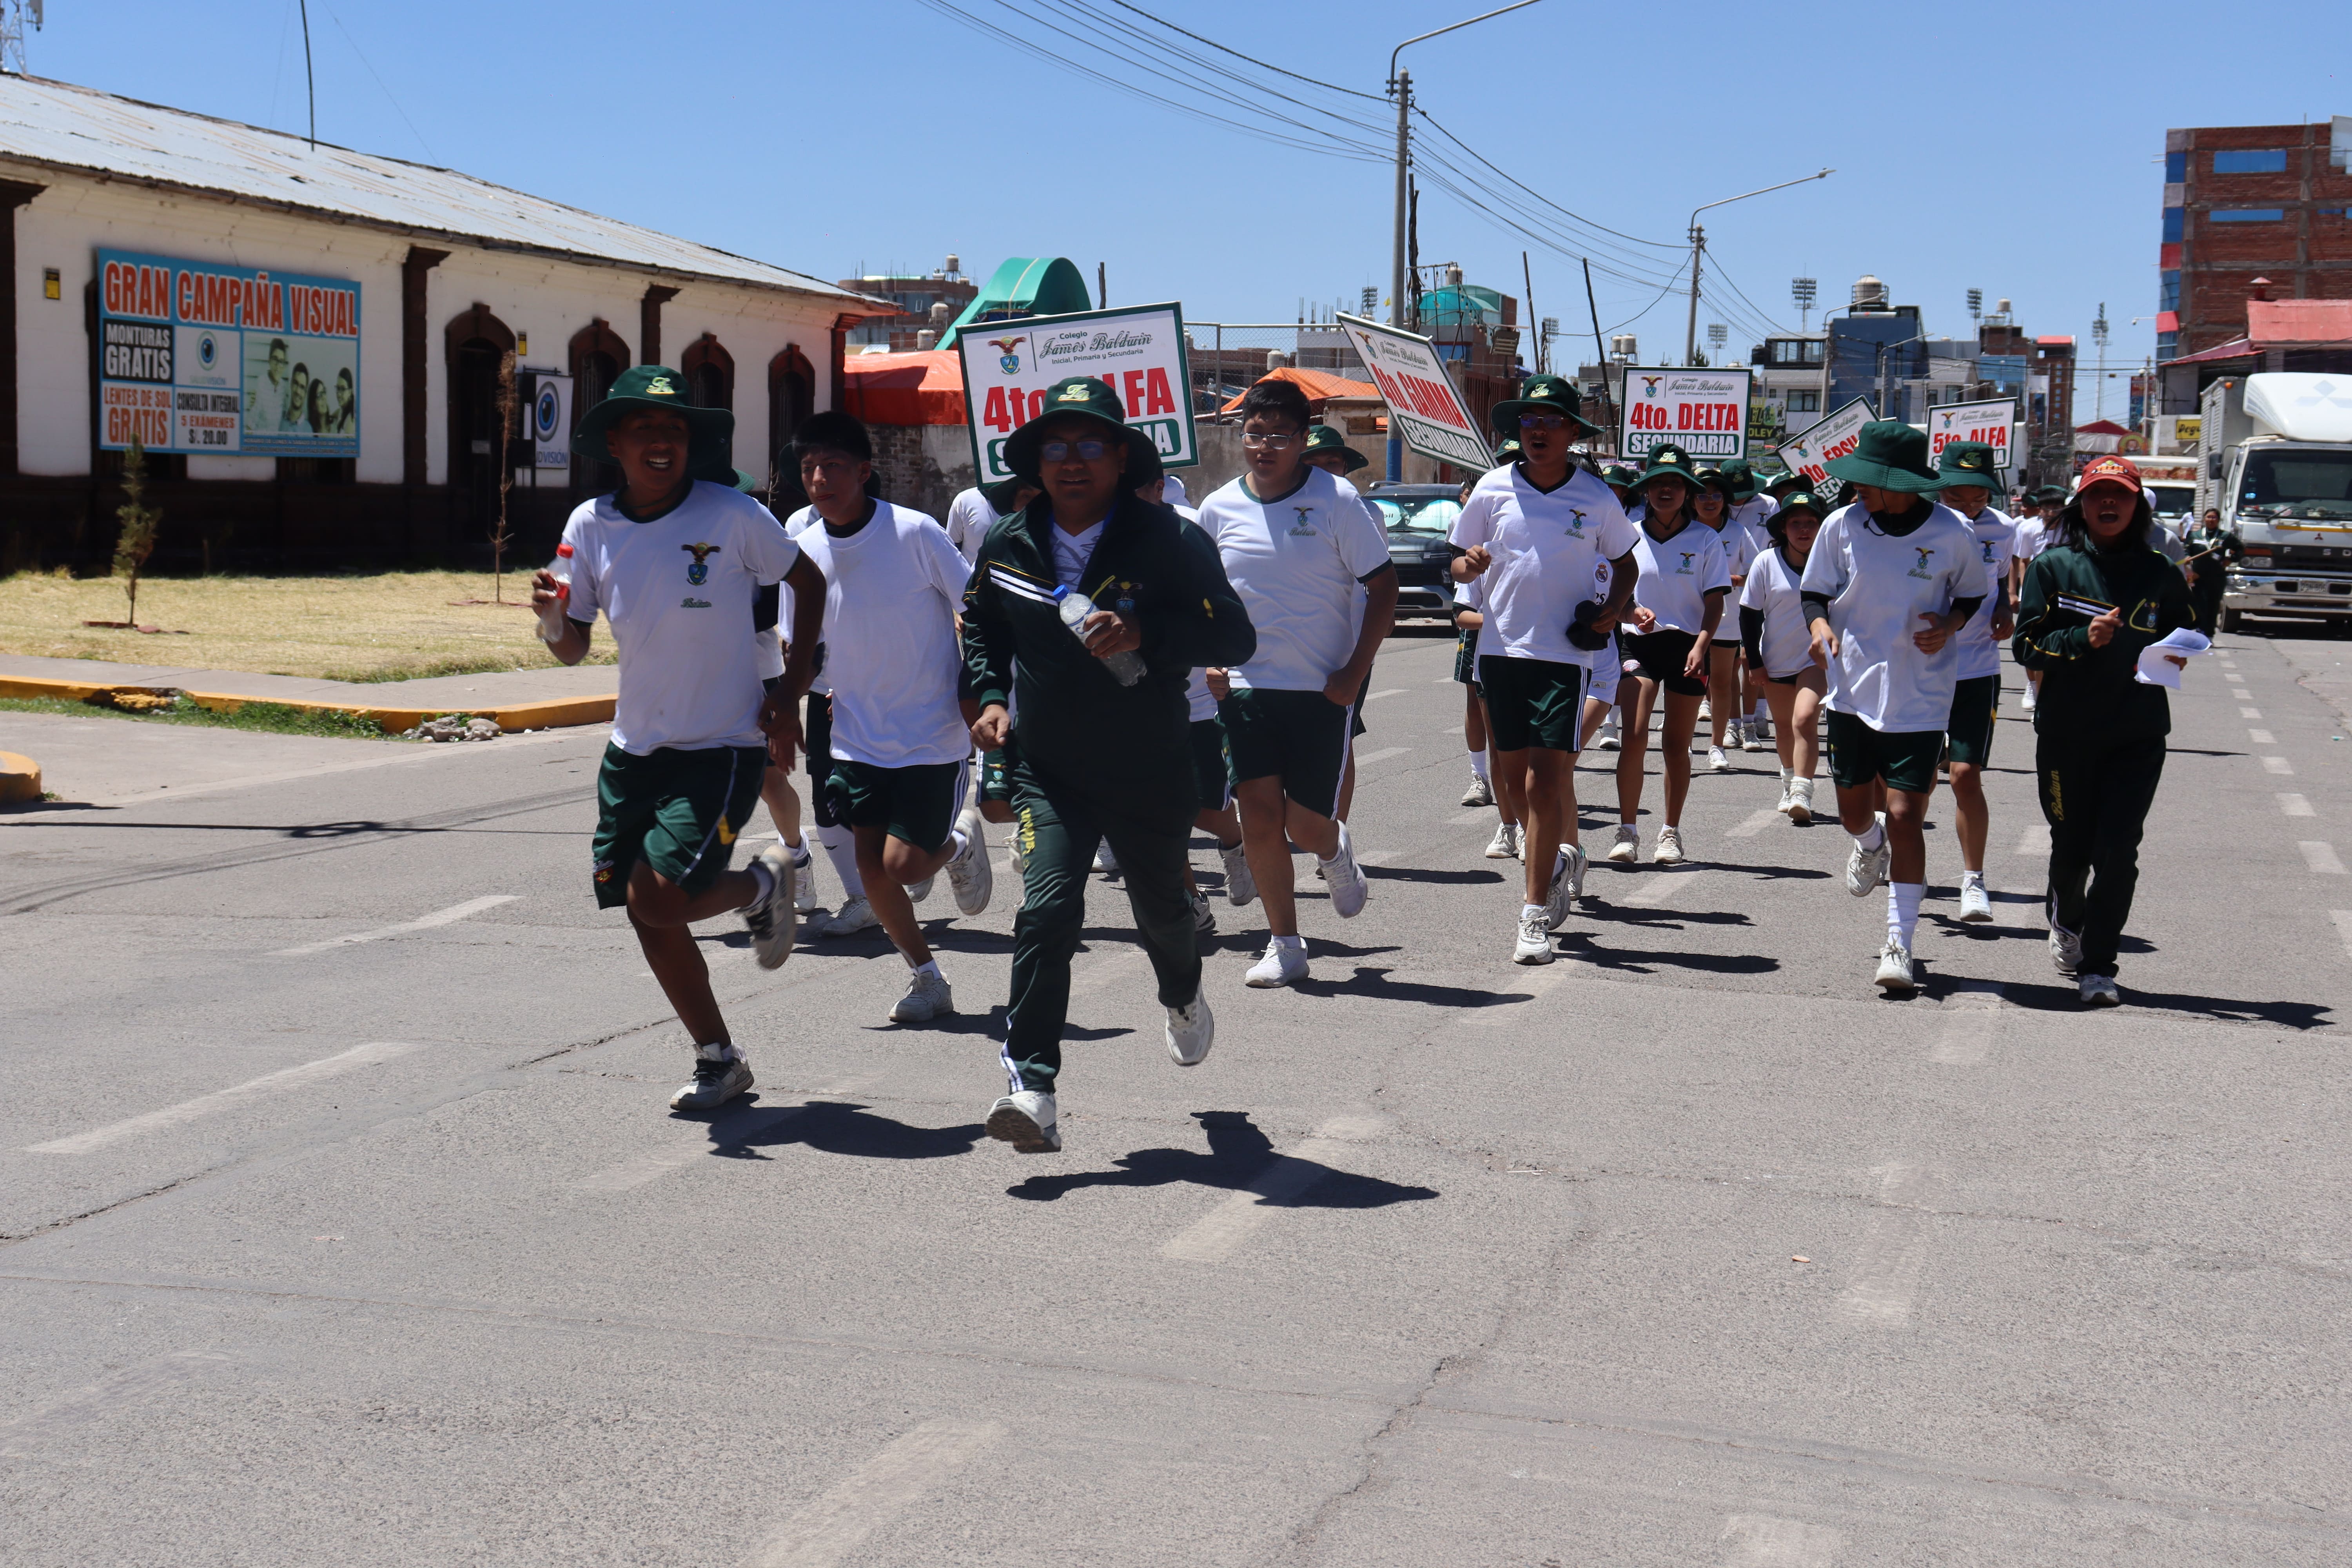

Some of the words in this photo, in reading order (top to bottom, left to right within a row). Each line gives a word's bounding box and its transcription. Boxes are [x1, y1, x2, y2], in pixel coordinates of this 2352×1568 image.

[104, 260, 171, 320] GRAN
[176, 271, 284, 331] CAMPAÑA
[289, 283, 358, 338] VISUAL
[106, 323, 171, 348] MONTURAS
[1039, 338, 1086, 359] James
[1089, 330, 1153, 352] Baldwin
[1059, 330, 1088, 340] Colegio
[105, 344, 171, 380] GRATIS
[1073, 353, 1101, 362] Primaria
[1107, 348, 1143, 358] Secundaria
[1379, 341, 1400, 358] James
[1399, 348, 1429, 366] Baldwin
[104, 387, 138, 407] LENTES
[141, 389, 152, 407] DE
[155, 390, 172, 408] SOL
[1370, 363, 1415, 413] 4to.
[1397, 371, 1471, 431] GAMMA
[1668, 379, 1696, 391] James
[1697, 380, 1735, 391] Baldwin
[177, 392, 209, 411] CONSULTA
[210, 394, 240, 414] INTEGRAL
[108, 407, 168, 445] GRATIS
[181, 415, 187, 426] 5
[189, 414, 235, 428] EXÁMENES
[1630, 402, 1672, 430] 4to.
[1678, 403, 1739, 431] DELTA
[1833, 413, 1859, 431] Baldwin
[202, 430, 227, 445] 20.00
[1401, 417, 1490, 468] SECUNDARIA
